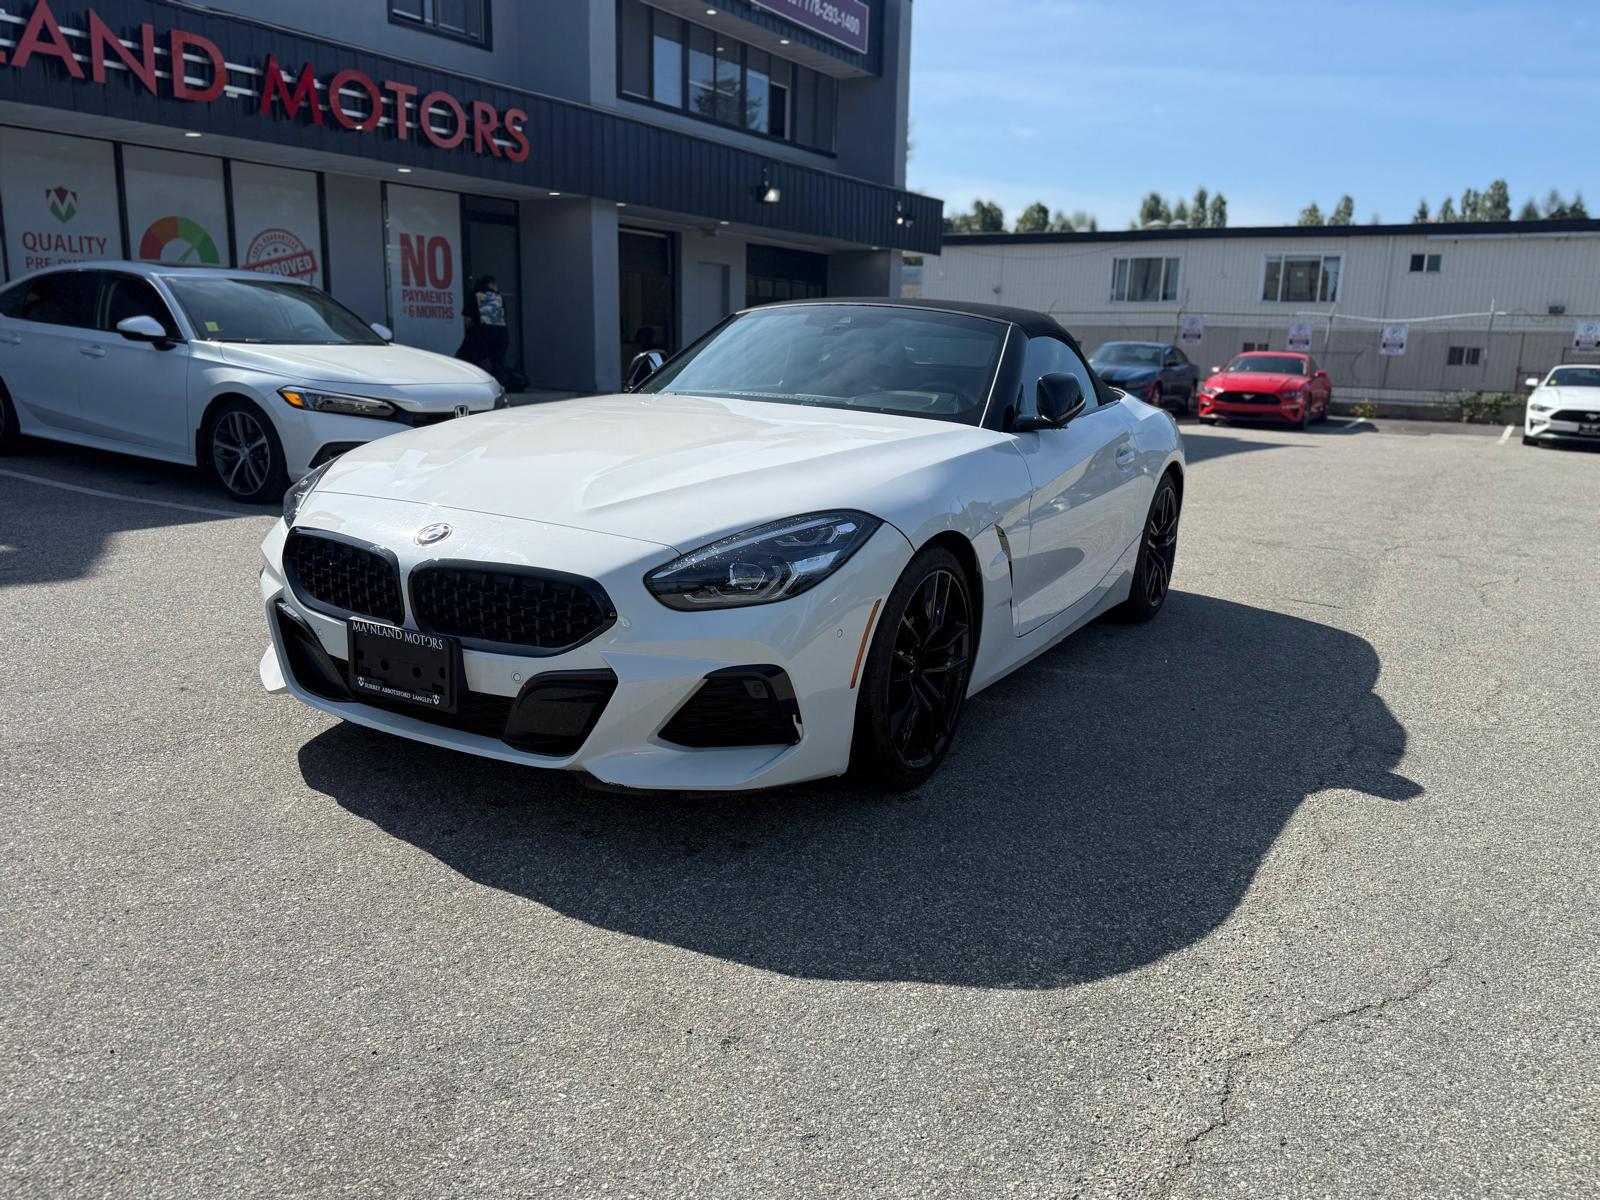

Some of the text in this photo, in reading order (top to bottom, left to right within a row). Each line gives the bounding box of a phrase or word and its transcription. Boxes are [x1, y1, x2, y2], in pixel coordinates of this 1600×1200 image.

[0, 0, 530, 163] AND MOTORS
[22, 231, 107, 255] QUALITY
[251, 255, 313, 276] PROVED
[400, 233, 453, 289] NO
[402, 289, 454, 305] PAYMENTS
[408, 304, 416, 318] 6
[416, 305, 454, 320] MONTHS
[405, 631, 443, 650] MOTORS
